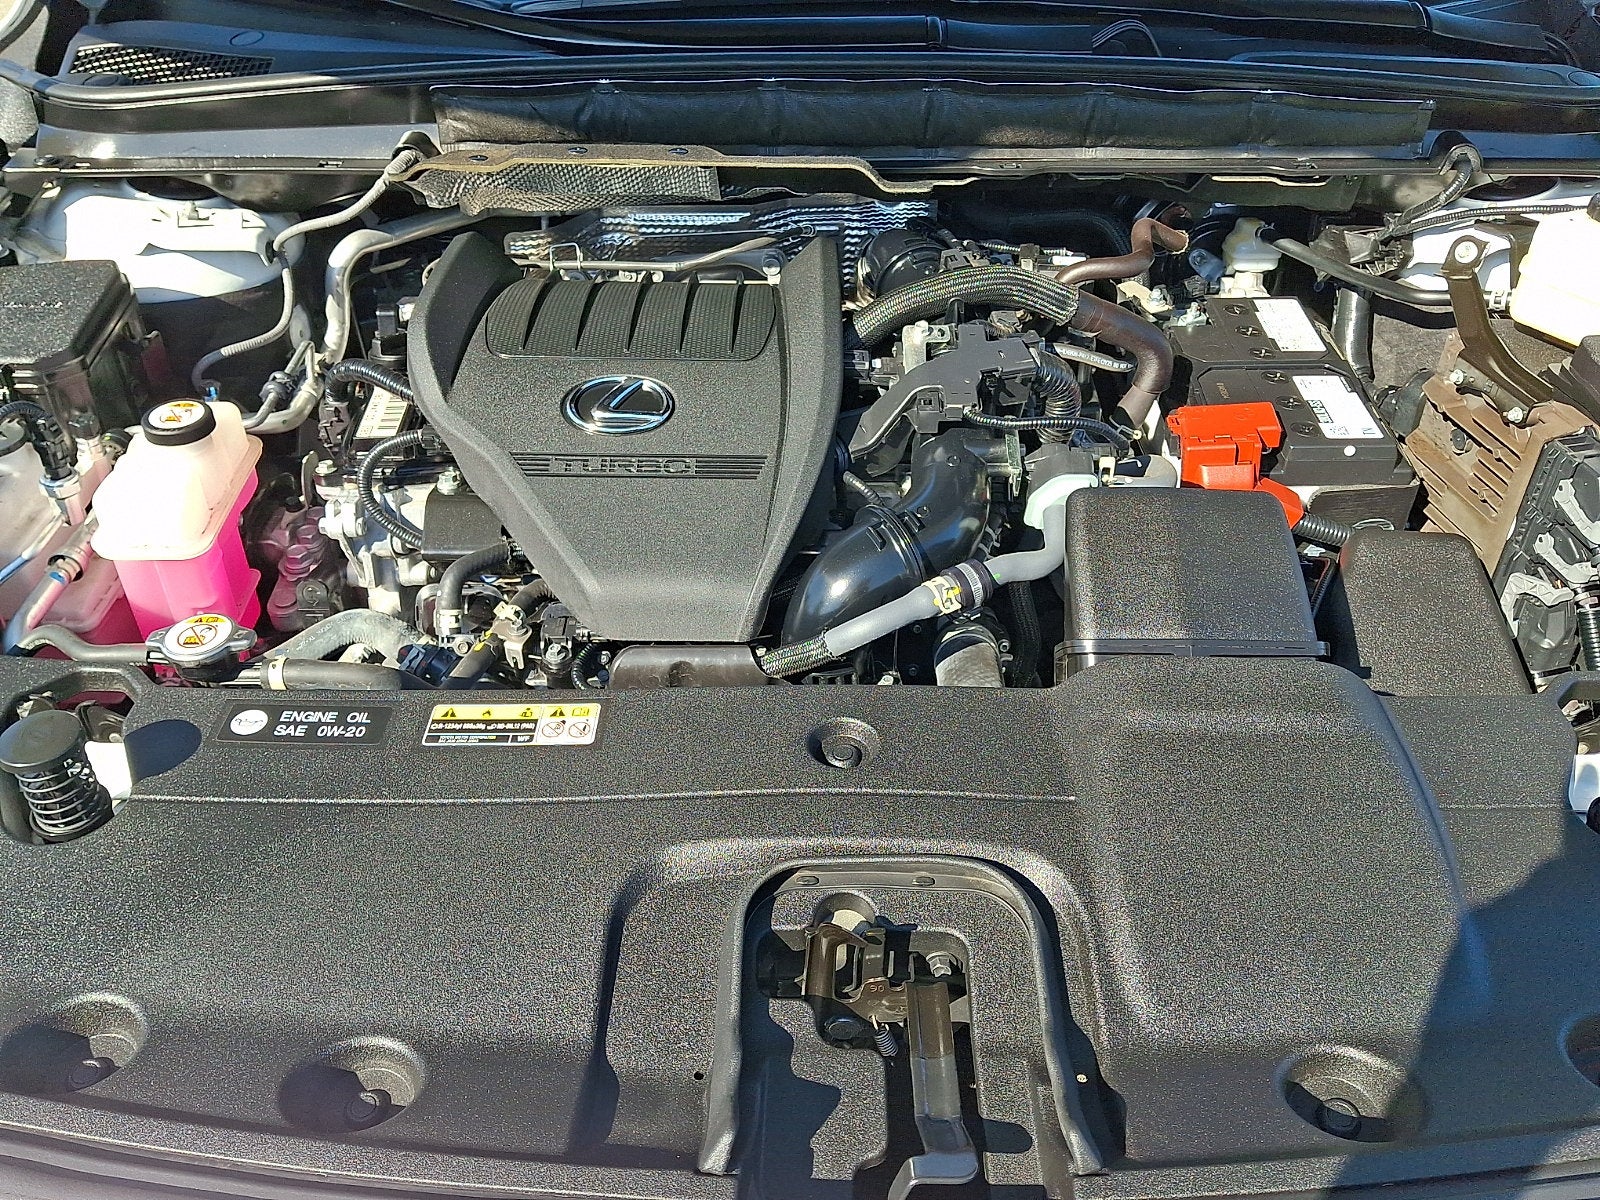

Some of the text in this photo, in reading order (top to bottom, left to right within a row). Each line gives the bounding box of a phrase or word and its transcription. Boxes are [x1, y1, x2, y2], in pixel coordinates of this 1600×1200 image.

[553, 457, 692, 474] TURBO
[280, 710, 371, 723] ENGINE OIL
[273, 724, 367, 738] SAE 0W-20
